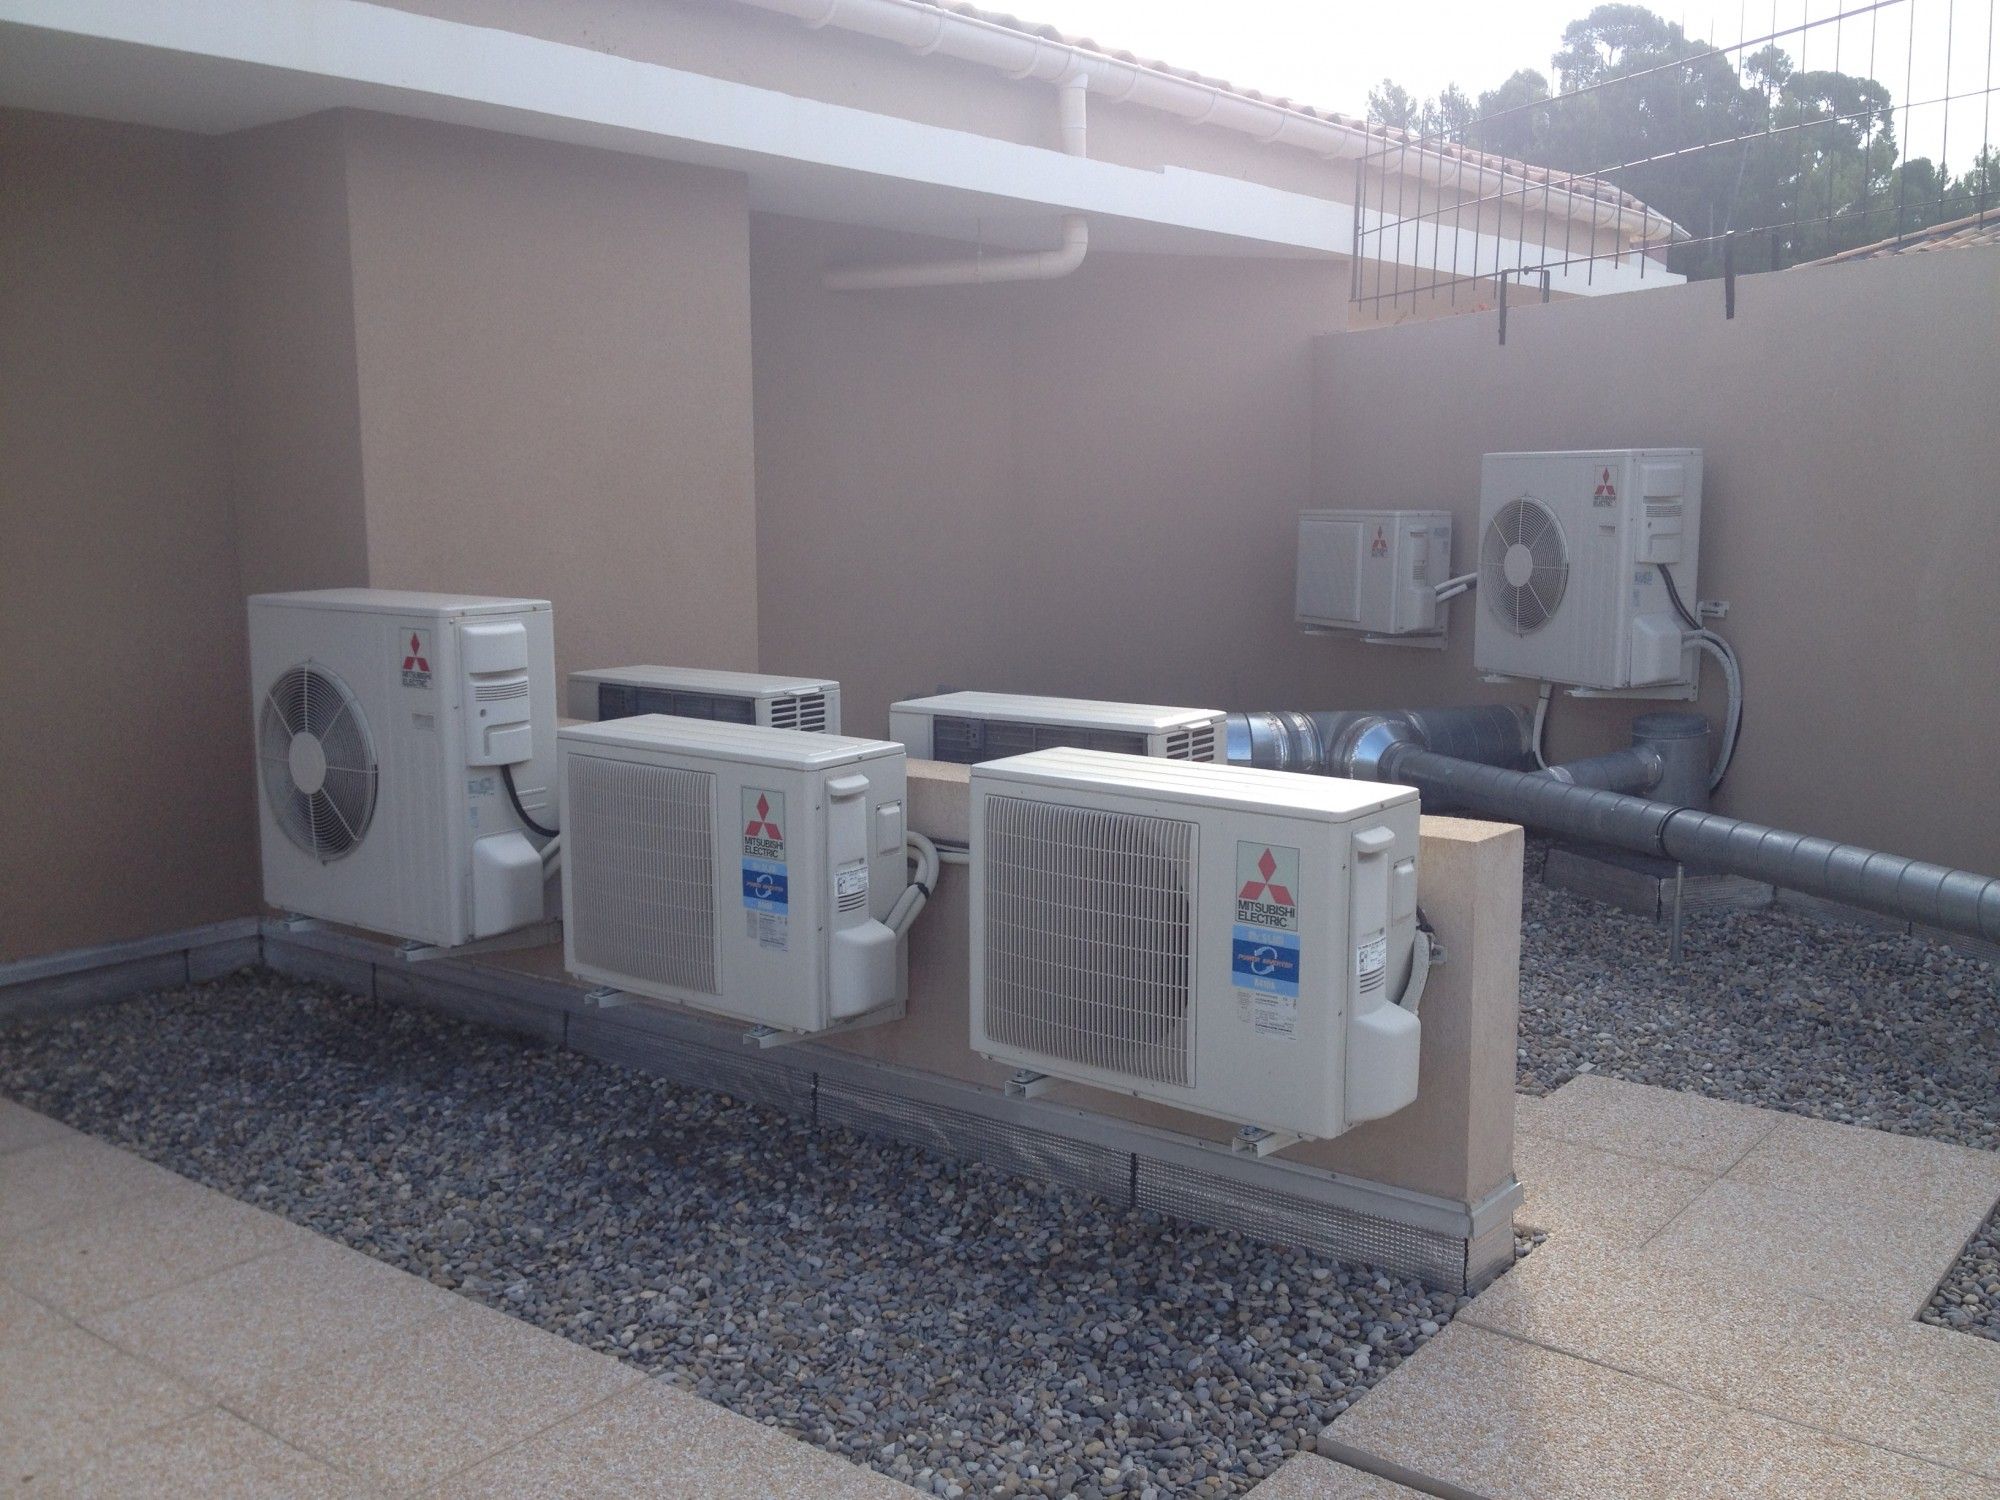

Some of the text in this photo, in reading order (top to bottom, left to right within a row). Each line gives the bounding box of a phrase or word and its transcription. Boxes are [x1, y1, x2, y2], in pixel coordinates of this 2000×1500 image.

[744, 836, 784, 850] MITSUBISHI
[744, 845, 779, 858] ELECTRIC
[1238, 899, 1296, 918] MITSUBISHI
[1238, 910, 1288, 928] ELECTRIC
